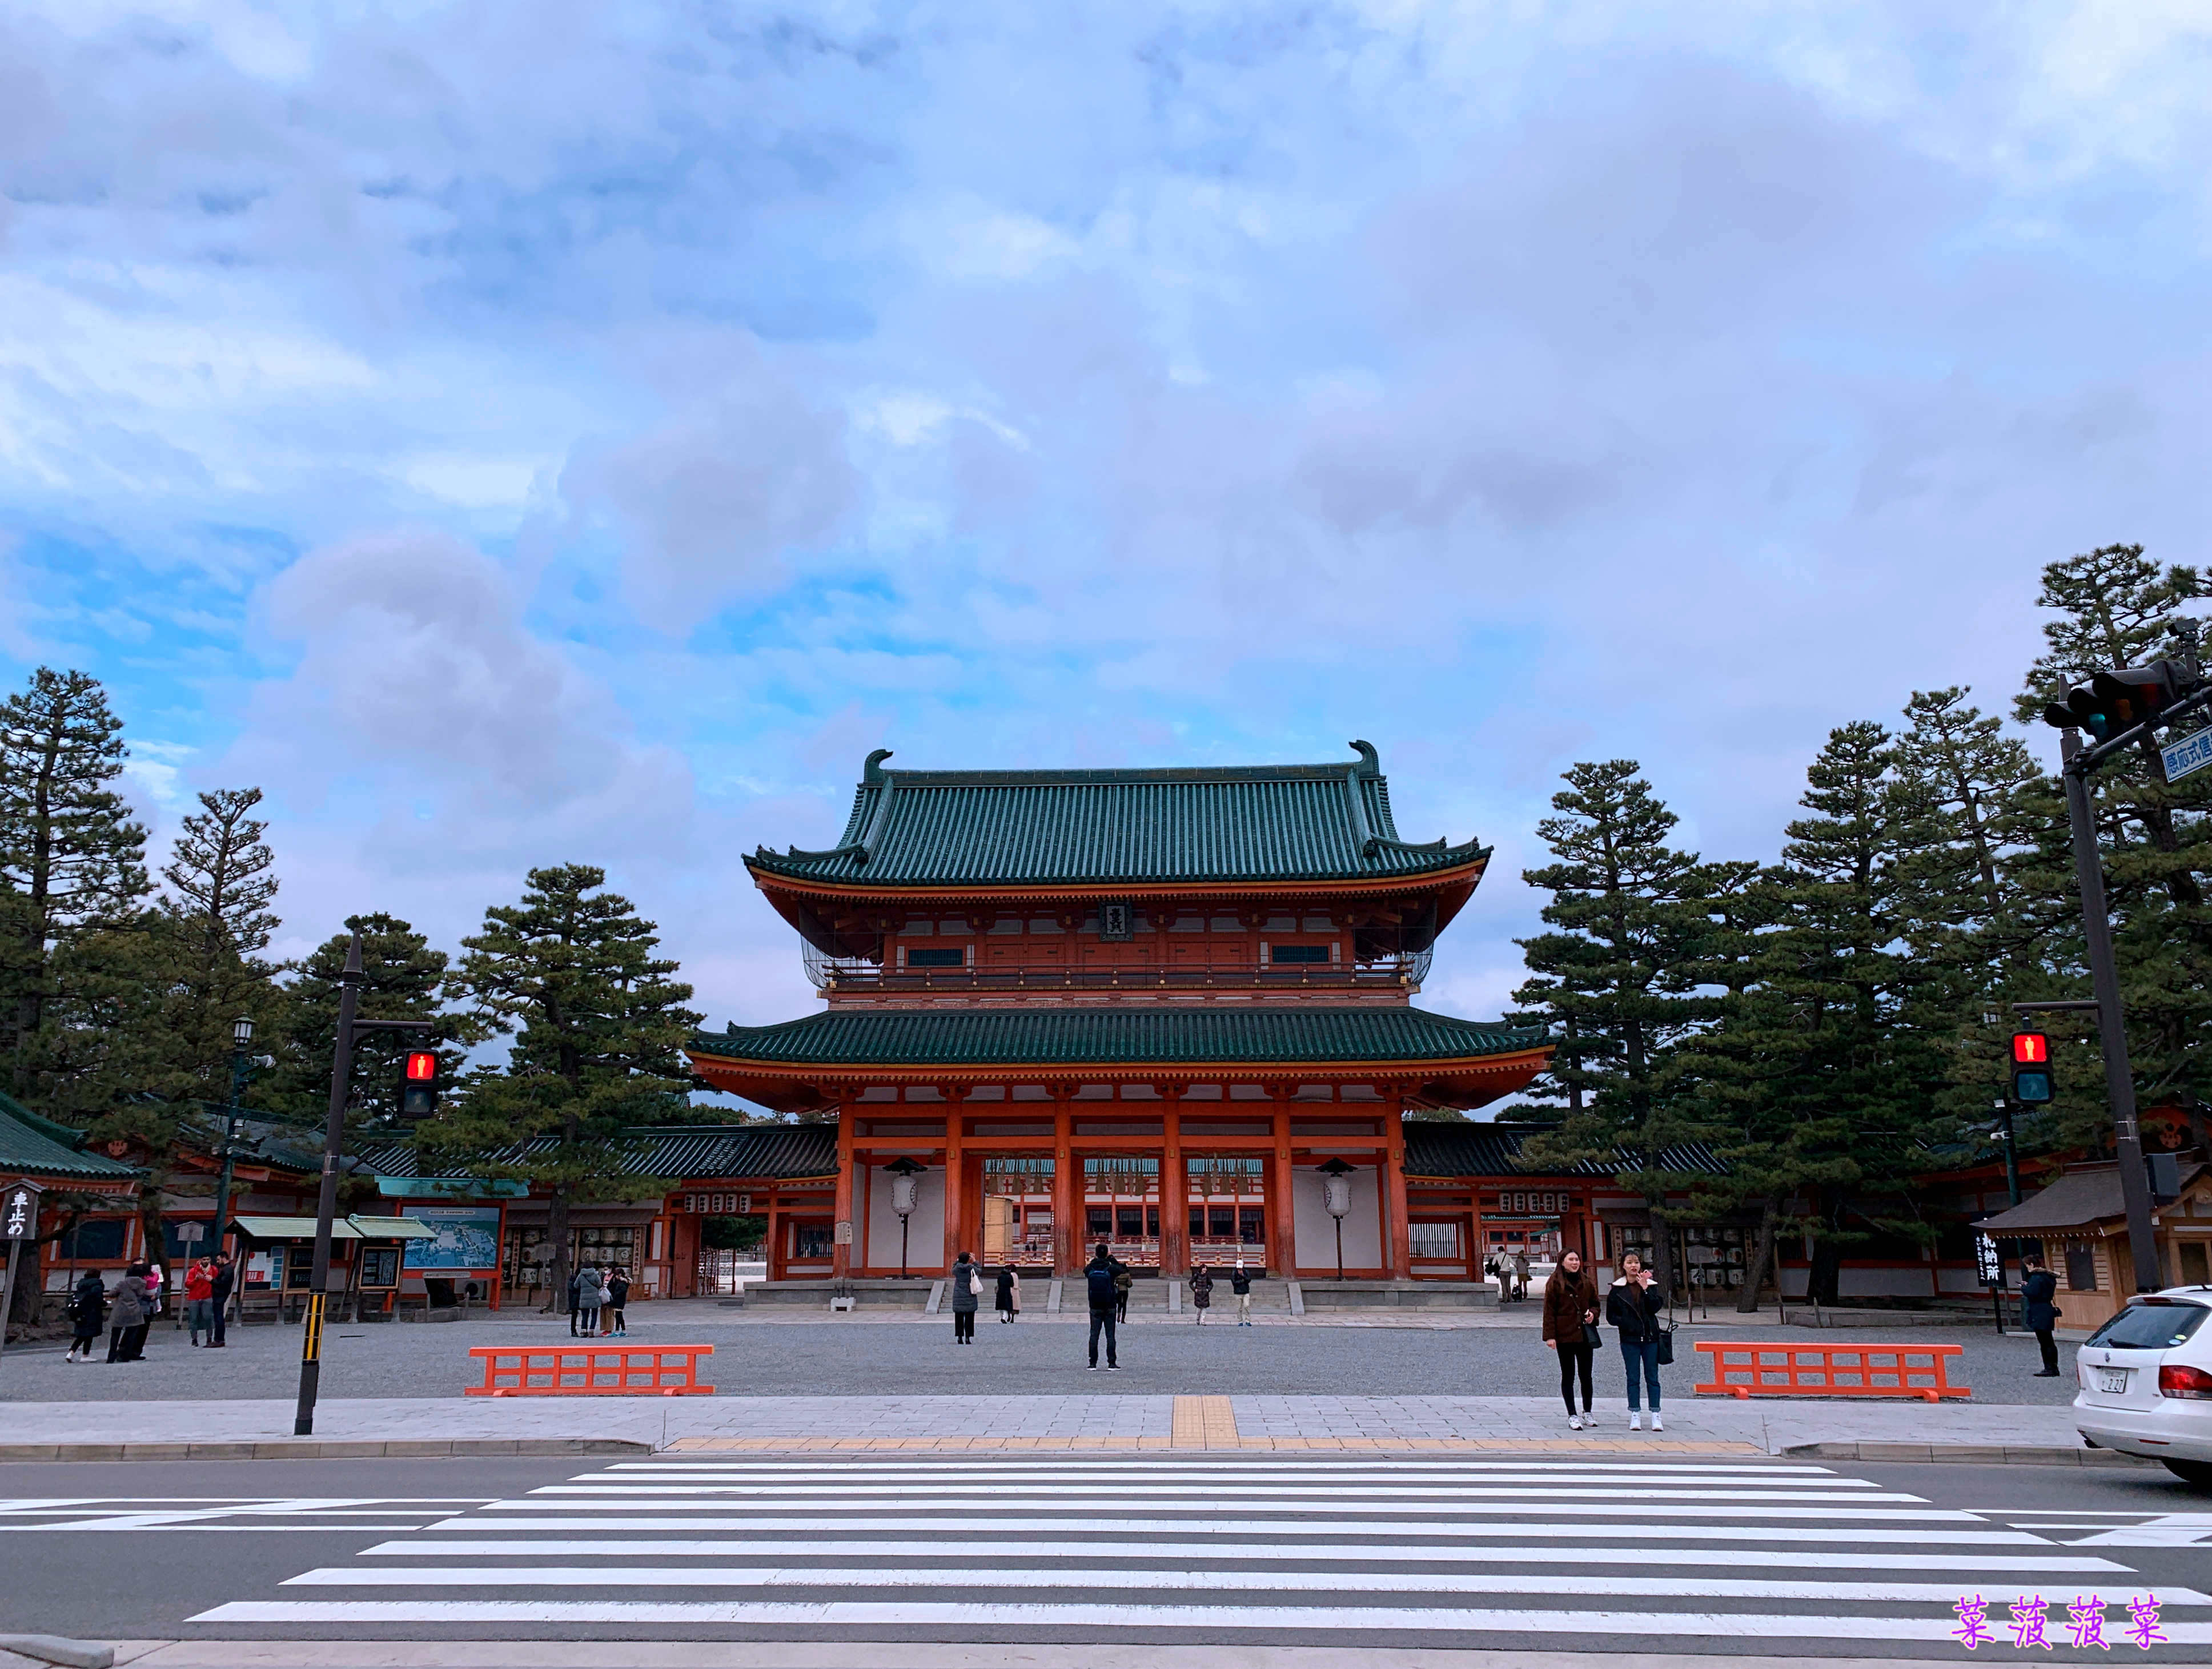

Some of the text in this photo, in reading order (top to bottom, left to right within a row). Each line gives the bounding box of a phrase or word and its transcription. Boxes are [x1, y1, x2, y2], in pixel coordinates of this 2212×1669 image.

[2166, 733, 2212, 775] 感応式信
[8, 1192, 28, 1235] 車止め
